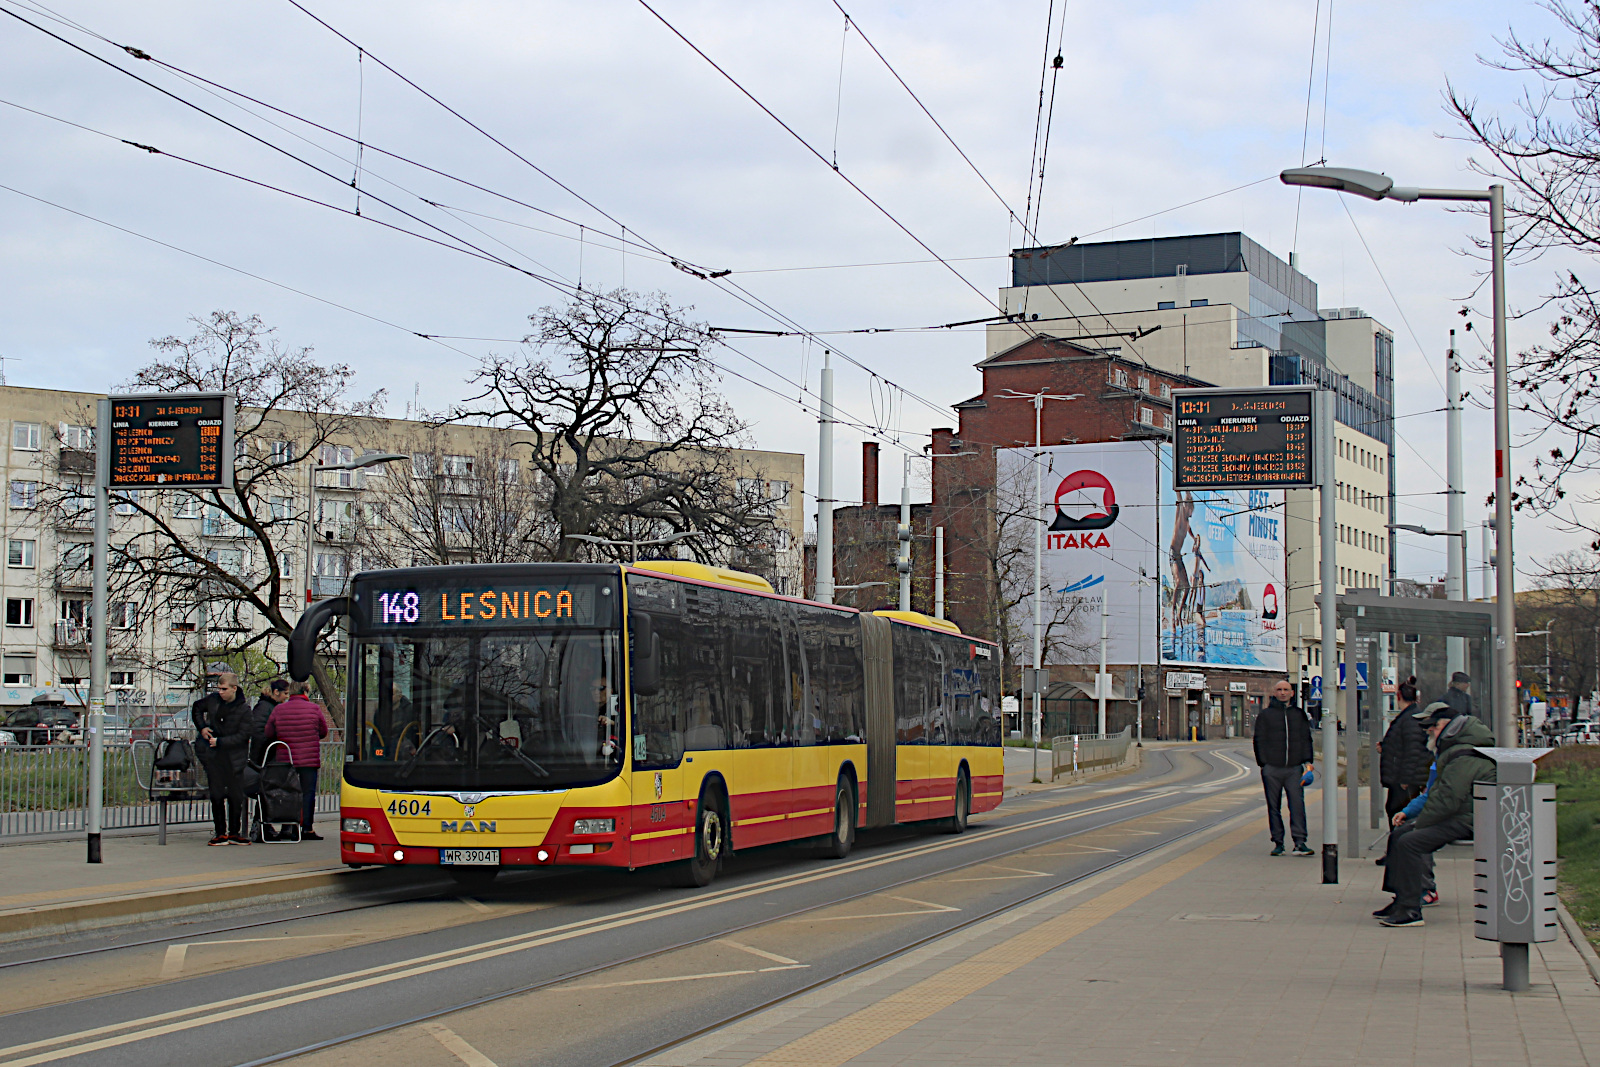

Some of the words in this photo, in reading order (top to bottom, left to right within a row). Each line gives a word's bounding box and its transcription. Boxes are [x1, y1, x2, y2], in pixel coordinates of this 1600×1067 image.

[115, 406, 140, 417] 13:31
[1180, 401, 1210, 413] 13:31
[1249, 490, 1269, 513] BEST
[1248, 514, 1278, 541] MINUTE
[1047, 532, 1111, 550] ITAKA
[379, 592, 419, 623] 148
[442, 590, 573, 620] LEŚNICA
[387, 800, 431, 816] 4604
[441, 820, 497, 833] MAN
[446, 851, 462, 861] WR
[465, 851, 498, 861] 3904T
